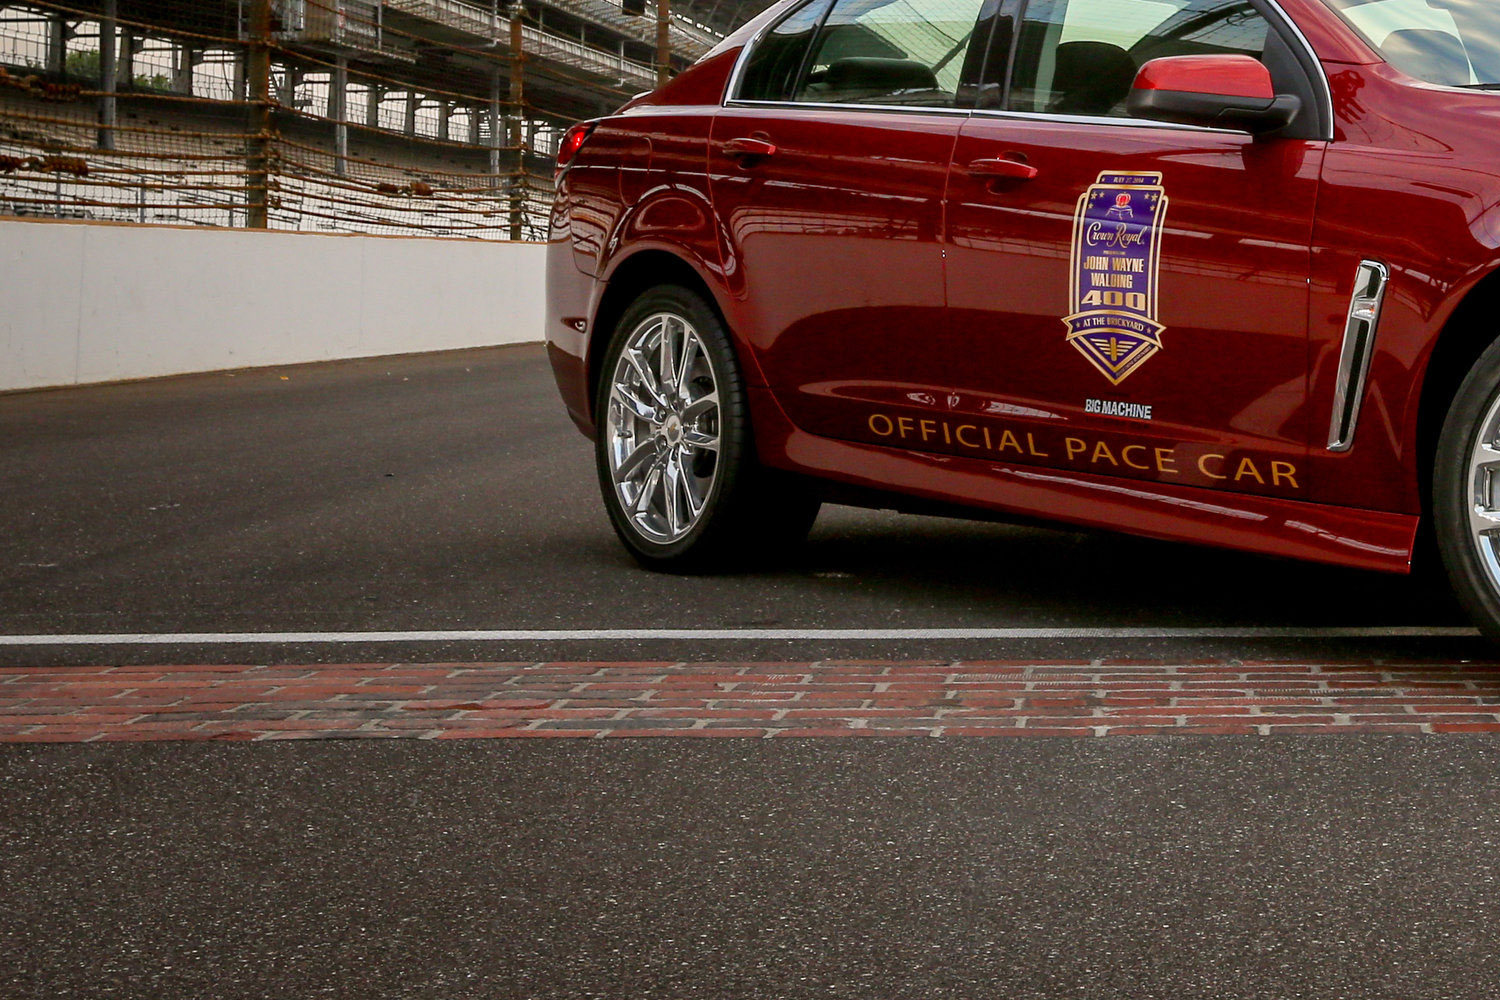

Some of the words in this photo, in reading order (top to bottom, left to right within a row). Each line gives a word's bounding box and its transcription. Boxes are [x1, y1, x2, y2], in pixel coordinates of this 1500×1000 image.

[1086, 221, 1115, 247] Crown
[1106, 222, 1148, 249] Royal
[1083, 255, 1109, 270] JOHN
[1112, 256, 1145, 273] WAYNE
[1091, 272, 1133, 289] WALDING
[1080, 289, 1146, 311] 400
[1083, 318, 1091, 328] AT
[1092, 316, 1105, 326] THE
[1106, 317, 1144, 332] BRICKYARD
[1085, 398, 1101, 413] BIG
[1101, 400, 1152, 420] MACHINE
[868, 413, 1049, 457] OFFICIAL
[1065, 437, 1179, 473] PACE
[1198, 453, 1300, 489] CAR
